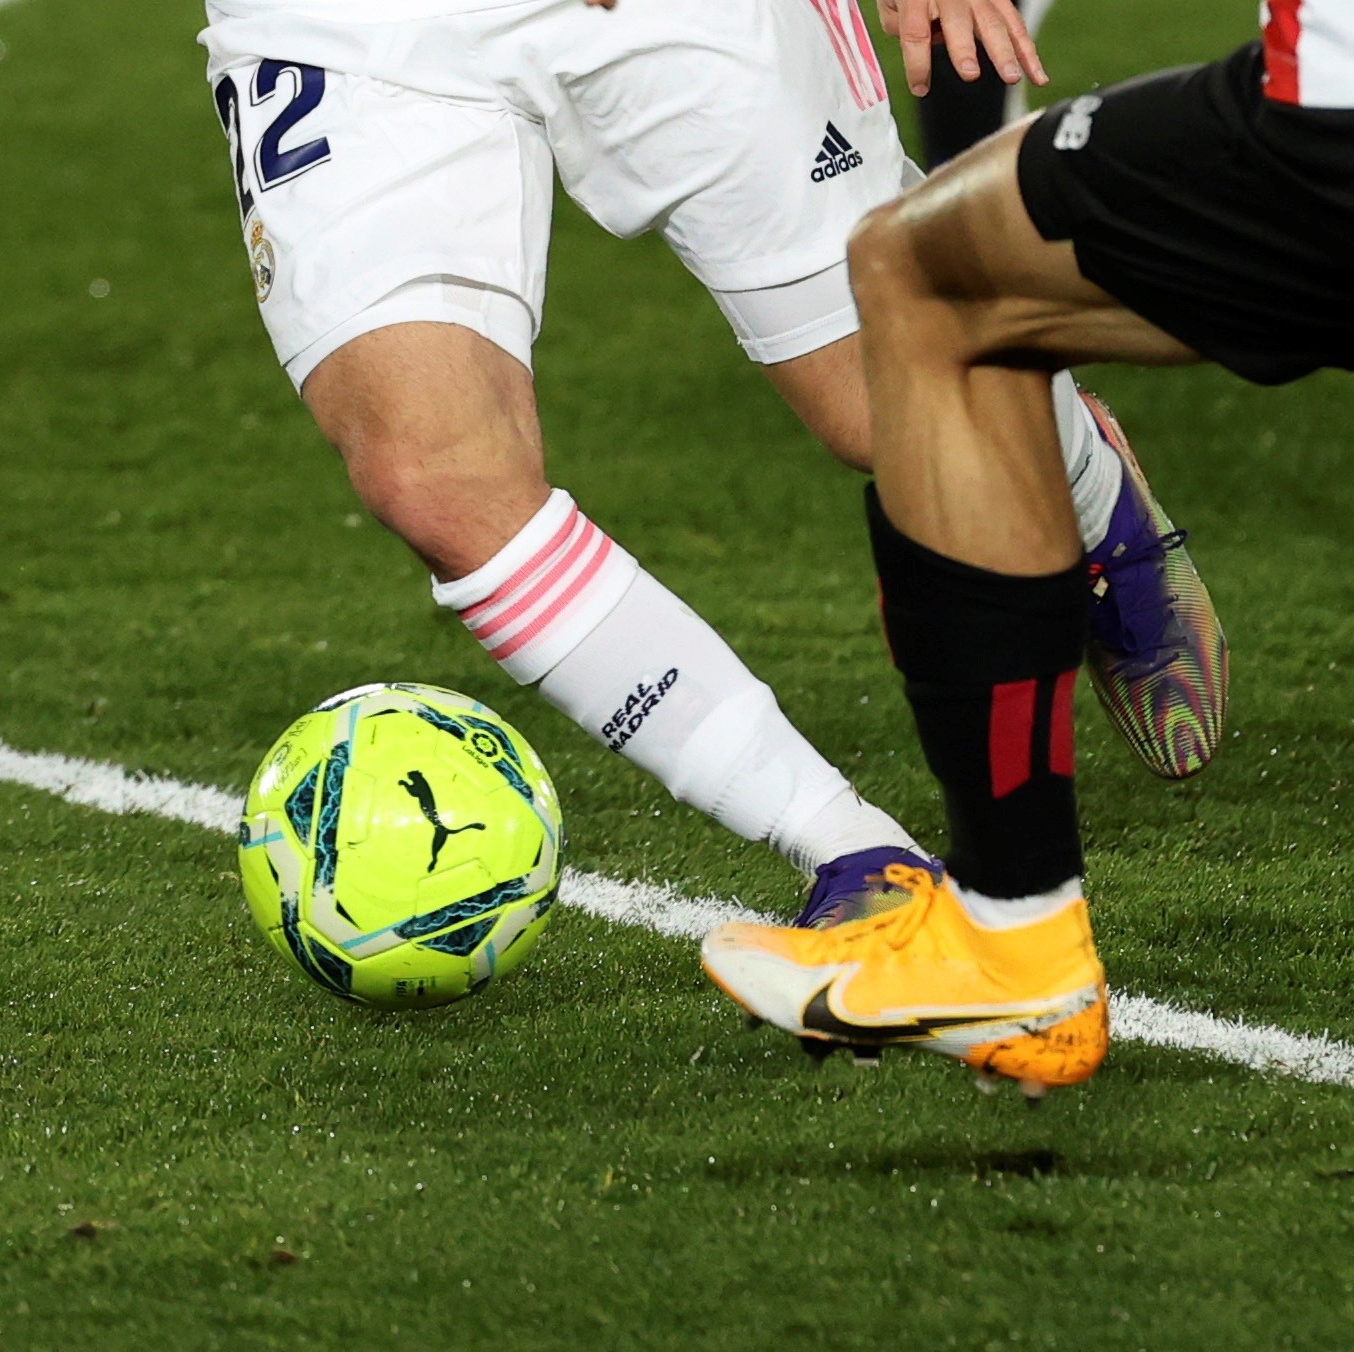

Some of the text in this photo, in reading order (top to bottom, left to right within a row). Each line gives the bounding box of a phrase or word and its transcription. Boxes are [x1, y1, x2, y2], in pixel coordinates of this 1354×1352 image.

[811, 150, 863, 183] adidas
[602, 683, 653, 738] REAL
[608, 667, 678, 754] MADRID
